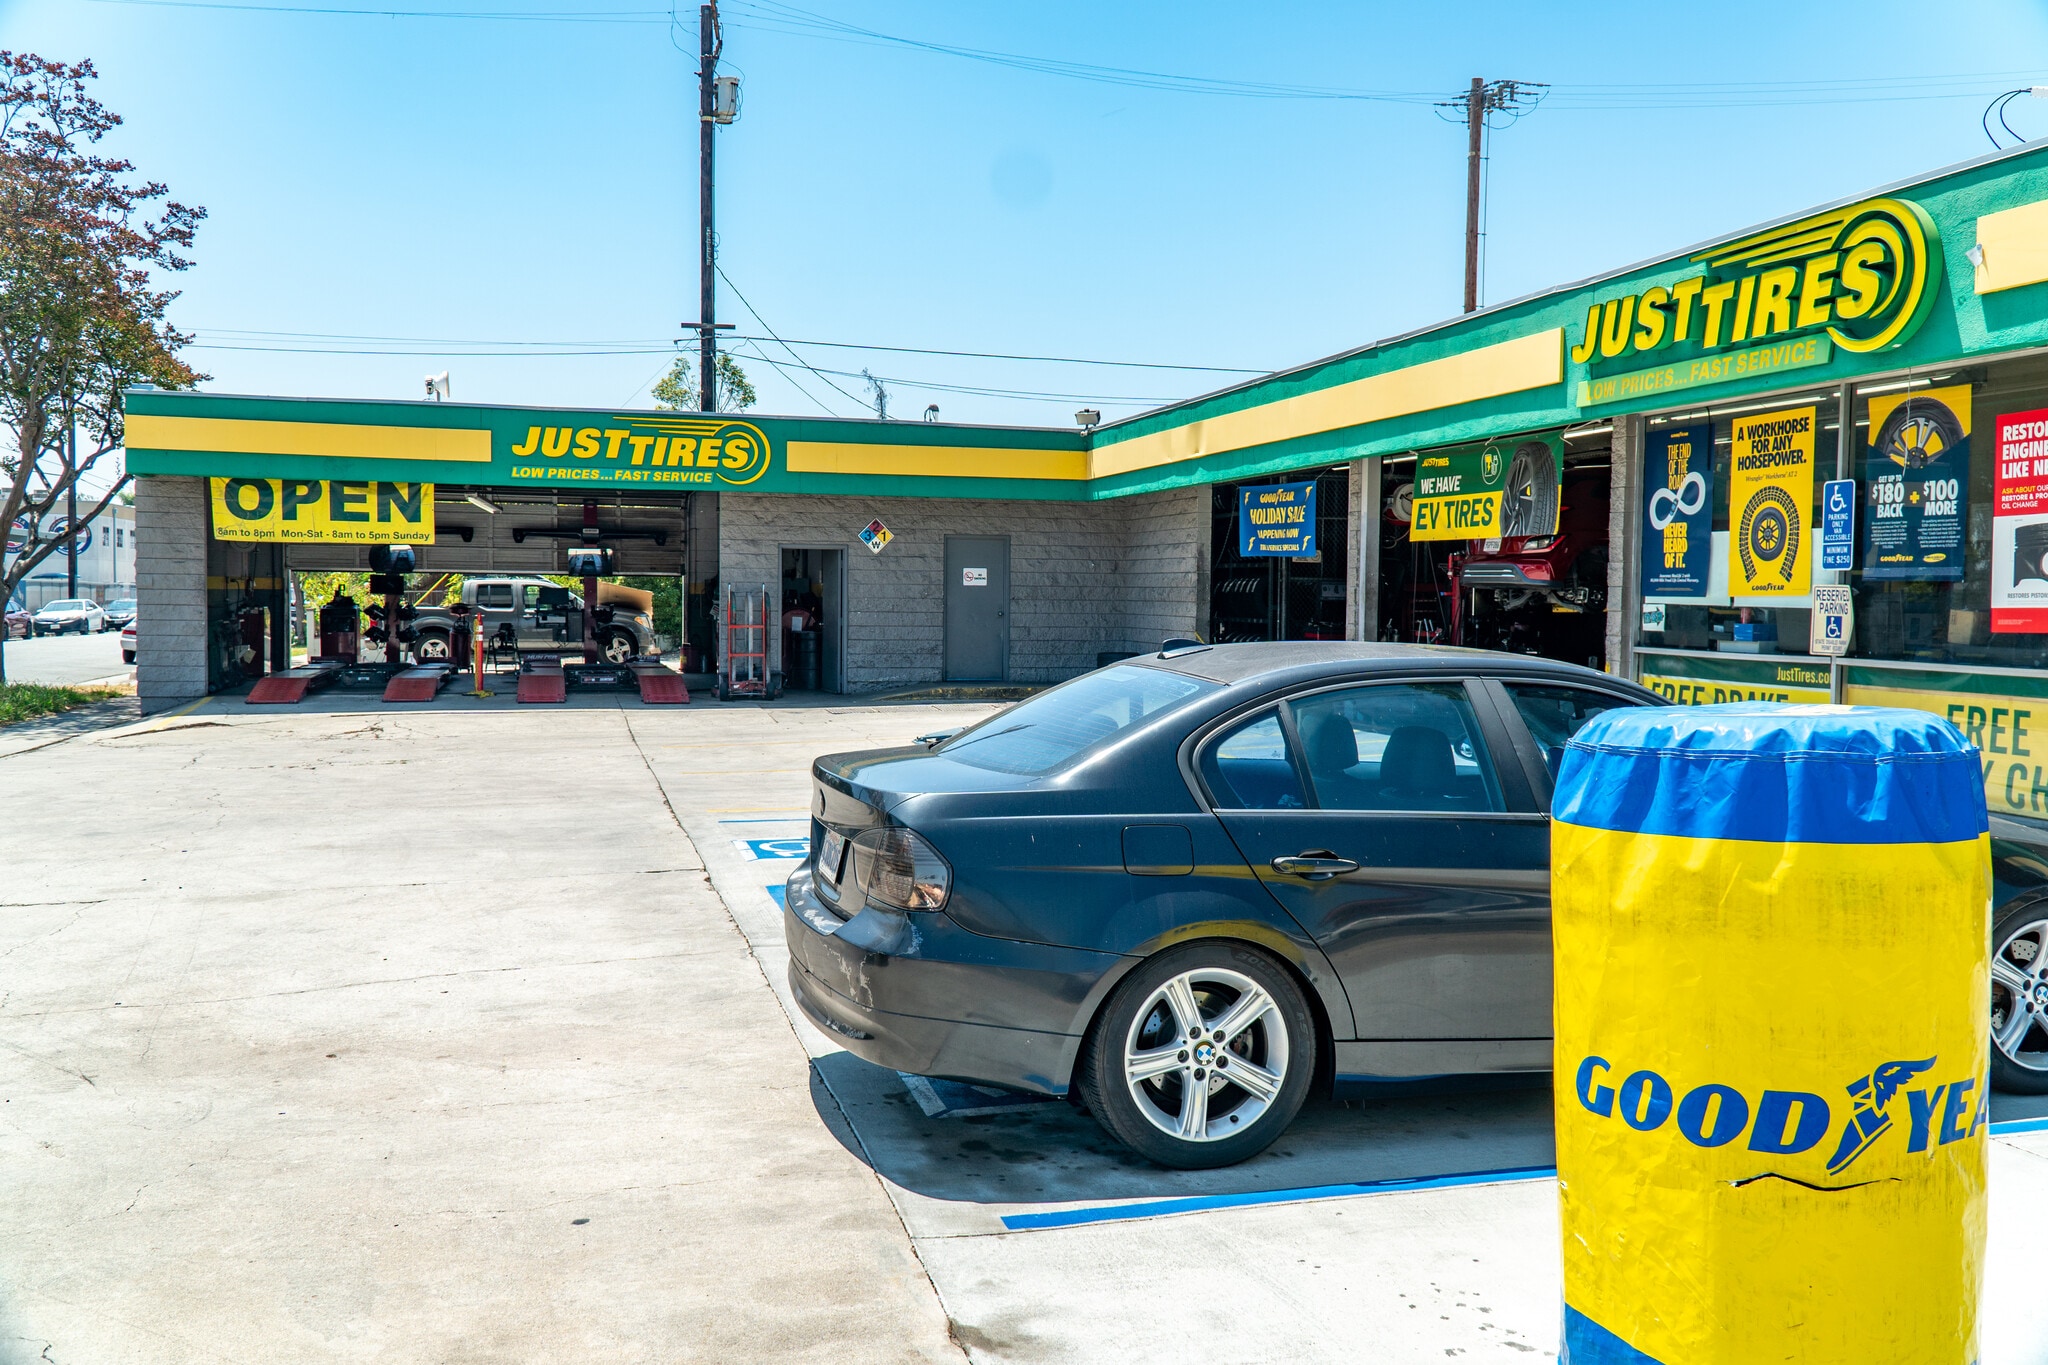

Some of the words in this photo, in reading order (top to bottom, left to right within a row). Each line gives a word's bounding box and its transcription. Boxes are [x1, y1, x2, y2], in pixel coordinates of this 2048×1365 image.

[1586, 380, 1617, 401] LOW
[1690, 357, 1733, 382] FAST
[1736, 340, 1817, 374] SERVICE
[1737, 427, 1744, 441] A
[1747, 417, 1810, 440] WORKHORSE
[1667, 444, 1679, 460] THE
[1679, 443, 1691, 459] END
[1751, 438, 1770, 454] FOR
[1772, 434, 1793, 452] ANY
[1668, 459, 1676, 475] OF
[1677, 458, 1688, 474] THE
[1737, 449, 1807, 471] HORSEPOWER.
[511, 467, 545, 478] LOW
[614, 470, 652, 481] FAST
[652, 471, 713, 483] SERVICE
[2002, 461, 2029, 479] LIKE
[1421, 478, 1435, 494] WE
[1435, 475, 1462, 493] HAVE
[1878, 475, 1887, 483] GET
[1260, 488, 1295, 505] GOODYEAR
[1872, 482, 1905, 504] $180
[1923, 478, 1959, 501] $100
[2002, 493, 2028, 502] RESTORE
[2015, 485, 2036, 494] ABOUT
[224, 477, 422, 523] OPEN
[2012, 500, 2039, 509] CHANGE
[1250, 507, 1286, 525] HOLIDAY
[1287, 505, 1306, 523] SALE
[1415, 501, 1440, 530] EV
[1444, 497, 1494, 528] TIRES
[1828, 513, 1849, 521] PARKING
[1877, 503, 1904, 518] BACK
[1924, 500, 1958, 516] MORE
[872, 522, 880, 533] 2
[1663, 522, 1687, 537] NEVER
[1831, 520, 1844, 528] ONLY
[217, 528, 238, 537] 8am
[240, 529, 251, 537] to
[253, 529, 275, 538] 8pm
[281, 529, 324, 538] Mon-Sat
[332, 530, 353, 539] 8am
[356, 531, 366, 539] to
[368, 531, 390, 540] 5pm
[393, 531, 430, 542] Sunday
[864, 529, 872, 541] 3
[881, 531, 886, 541] 1
[871, 541, 881, 549] W
[1663, 537, 1688, 553] HEARD
[1826, 546, 1848, 554] MINIMUM
[1664, 553, 1675, 568] OF
[1824, 555, 1835, 564] FINE
[1836, 555, 1851, 564] $250
[1880, 553, 1913, 562] GOODYEAR
[1751, 582, 1785, 591] GOODYEAR
[1816, 589, 1850, 601] RESERVED
[1819, 602, 1848, 615] PARKING
[1777, 667, 1832, 684] JustTires.co
[1947, 704, 2031, 757] FREE
[1575, 1055, 1831, 1155] GOOD
